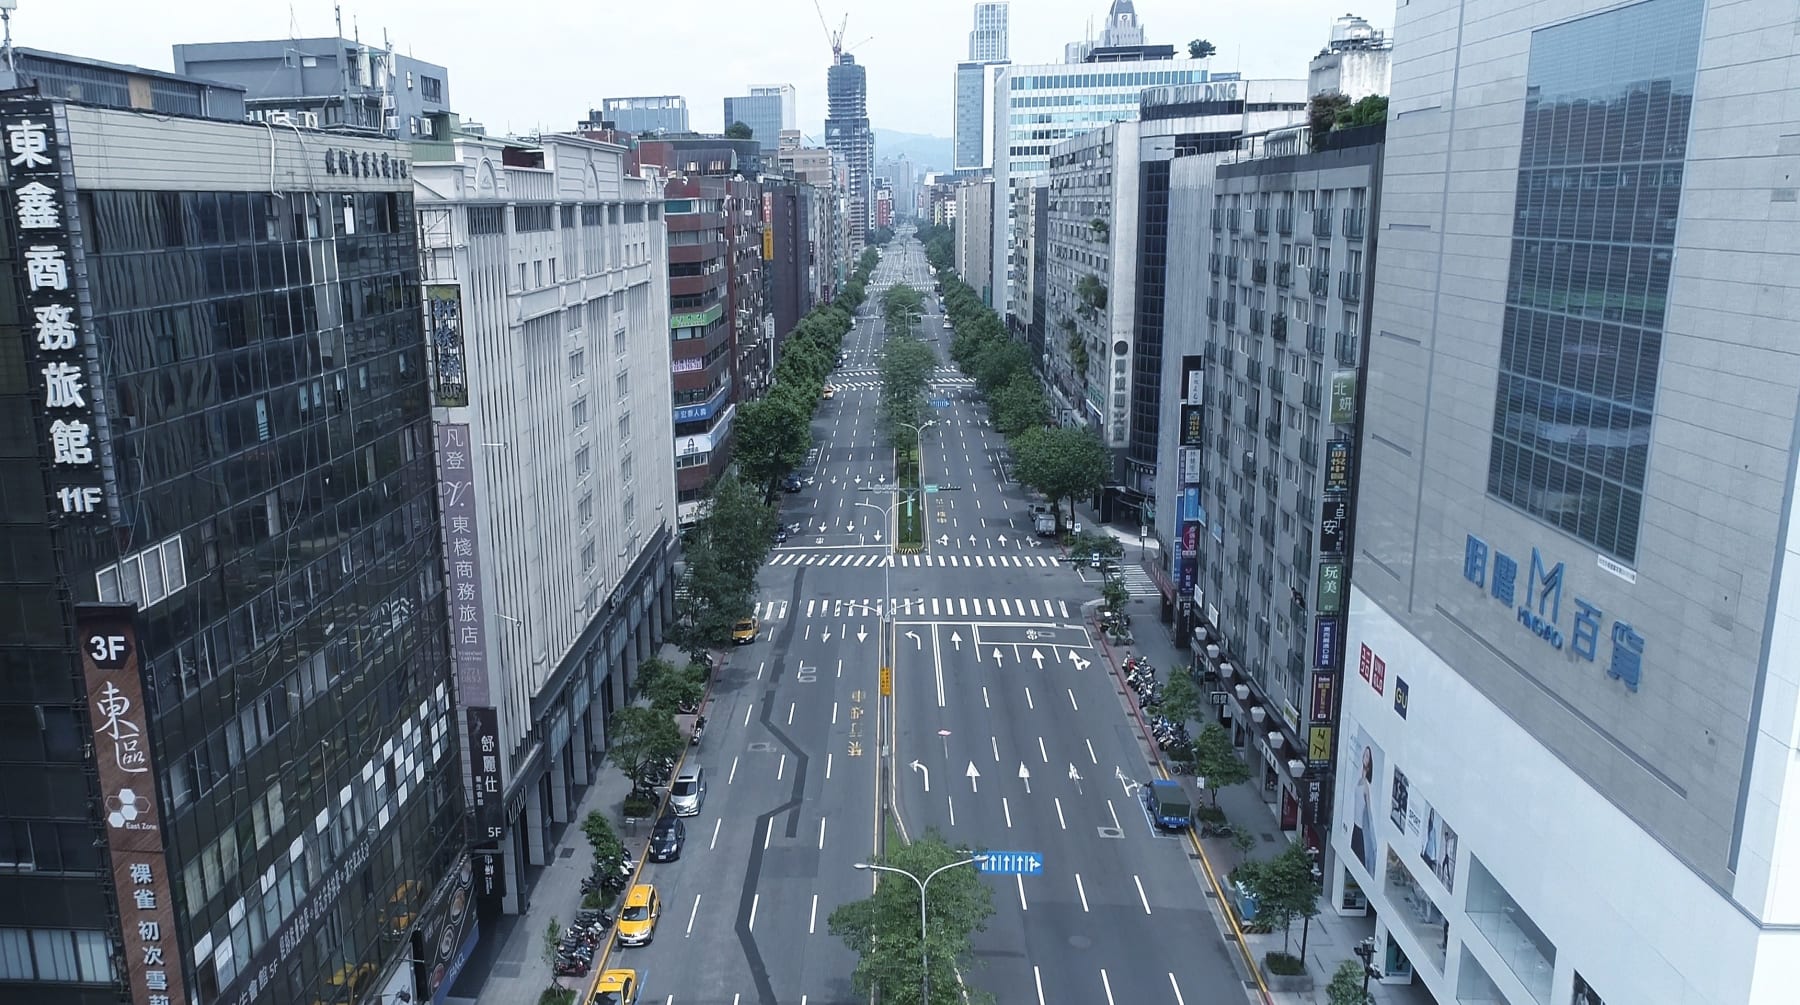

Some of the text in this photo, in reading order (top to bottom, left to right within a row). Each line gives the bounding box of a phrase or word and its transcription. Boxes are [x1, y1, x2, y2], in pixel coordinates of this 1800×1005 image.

[1174, 83, 1238, 104] BUILDING
[6, 118, 101, 513] 東鑫商務旅館 11F
[1333, 381, 1353, 411] 北妍
[445, 428, 465, 470] 凡登
[1323, 503, 1346, 535] 卓安
[452, 515, 479, 645] 東棧商務旅店
[1324, 566, 1338, 594] 玩美
[1464, 533, 1517, 609] 明曜
[1571, 596, 1645, 693] 百貨
[90, 635, 126, 661] 3F
[1396, 687, 1408, 709] GU
[96, 682, 148, 773] 東區
[481, 735, 498, 793] 舒麗仕
[125, 821, 157, 831] East Zone
[488, 826, 502, 838] 5F
[129, 863, 157, 910] 裸雀
